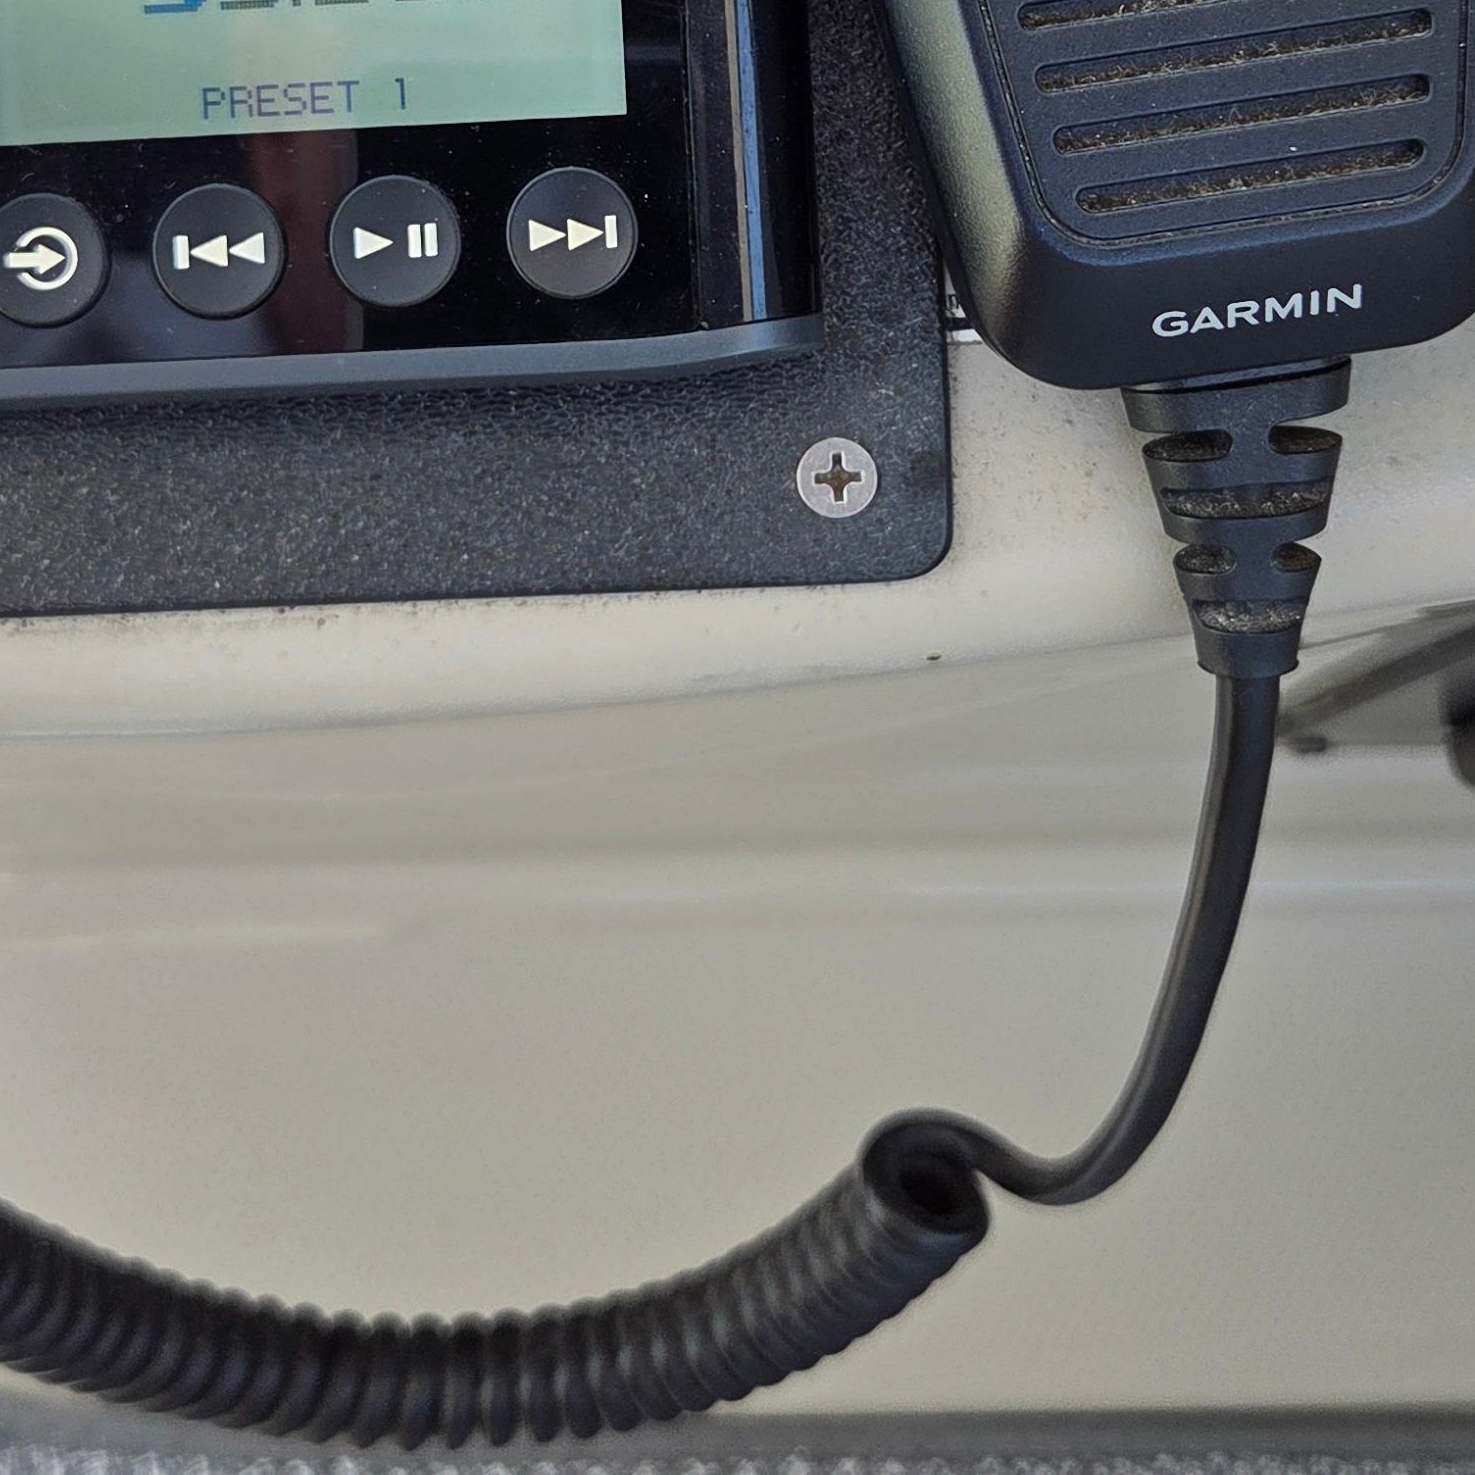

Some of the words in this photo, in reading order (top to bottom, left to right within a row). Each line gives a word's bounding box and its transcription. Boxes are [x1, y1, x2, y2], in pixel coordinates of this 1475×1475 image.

[201, 79, 361, 121] PRESET
[394, 76, 407, 111] 1
[1151, 282, 1363, 338] GARMIN
